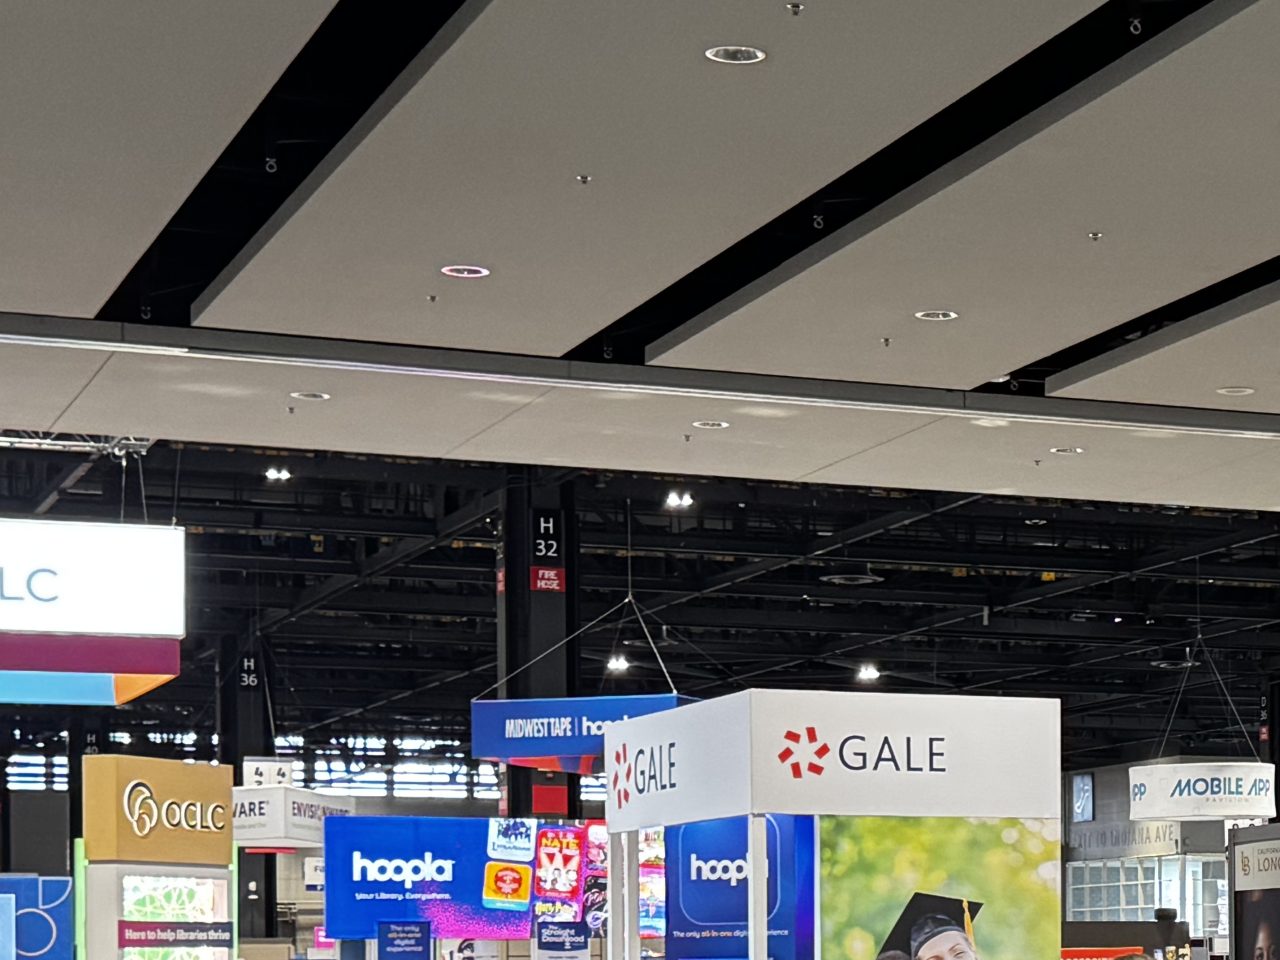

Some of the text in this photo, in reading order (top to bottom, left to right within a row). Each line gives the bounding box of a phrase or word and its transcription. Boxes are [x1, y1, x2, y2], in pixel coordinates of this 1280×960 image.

[540, 517, 554, 534] H
[535, 540, 558, 557] 32
[244, 658, 255, 670] H
[240, 674, 258, 686] 36
[505, 717, 572, 738] MIDWEST TAPE
[839, 735, 946, 772] GALE
[633, 742, 677, 794] GALE
[1170, 777, 1270, 797] MOBILE APP
[162, 799, 226, 831] OCLC
[541, 838, 579, 849] NATE
[352, 851, 455, 889] hoopla
[690, 853, 768, 886] hoop
[125, 928, 231, 941] Here to help libraries thrive
